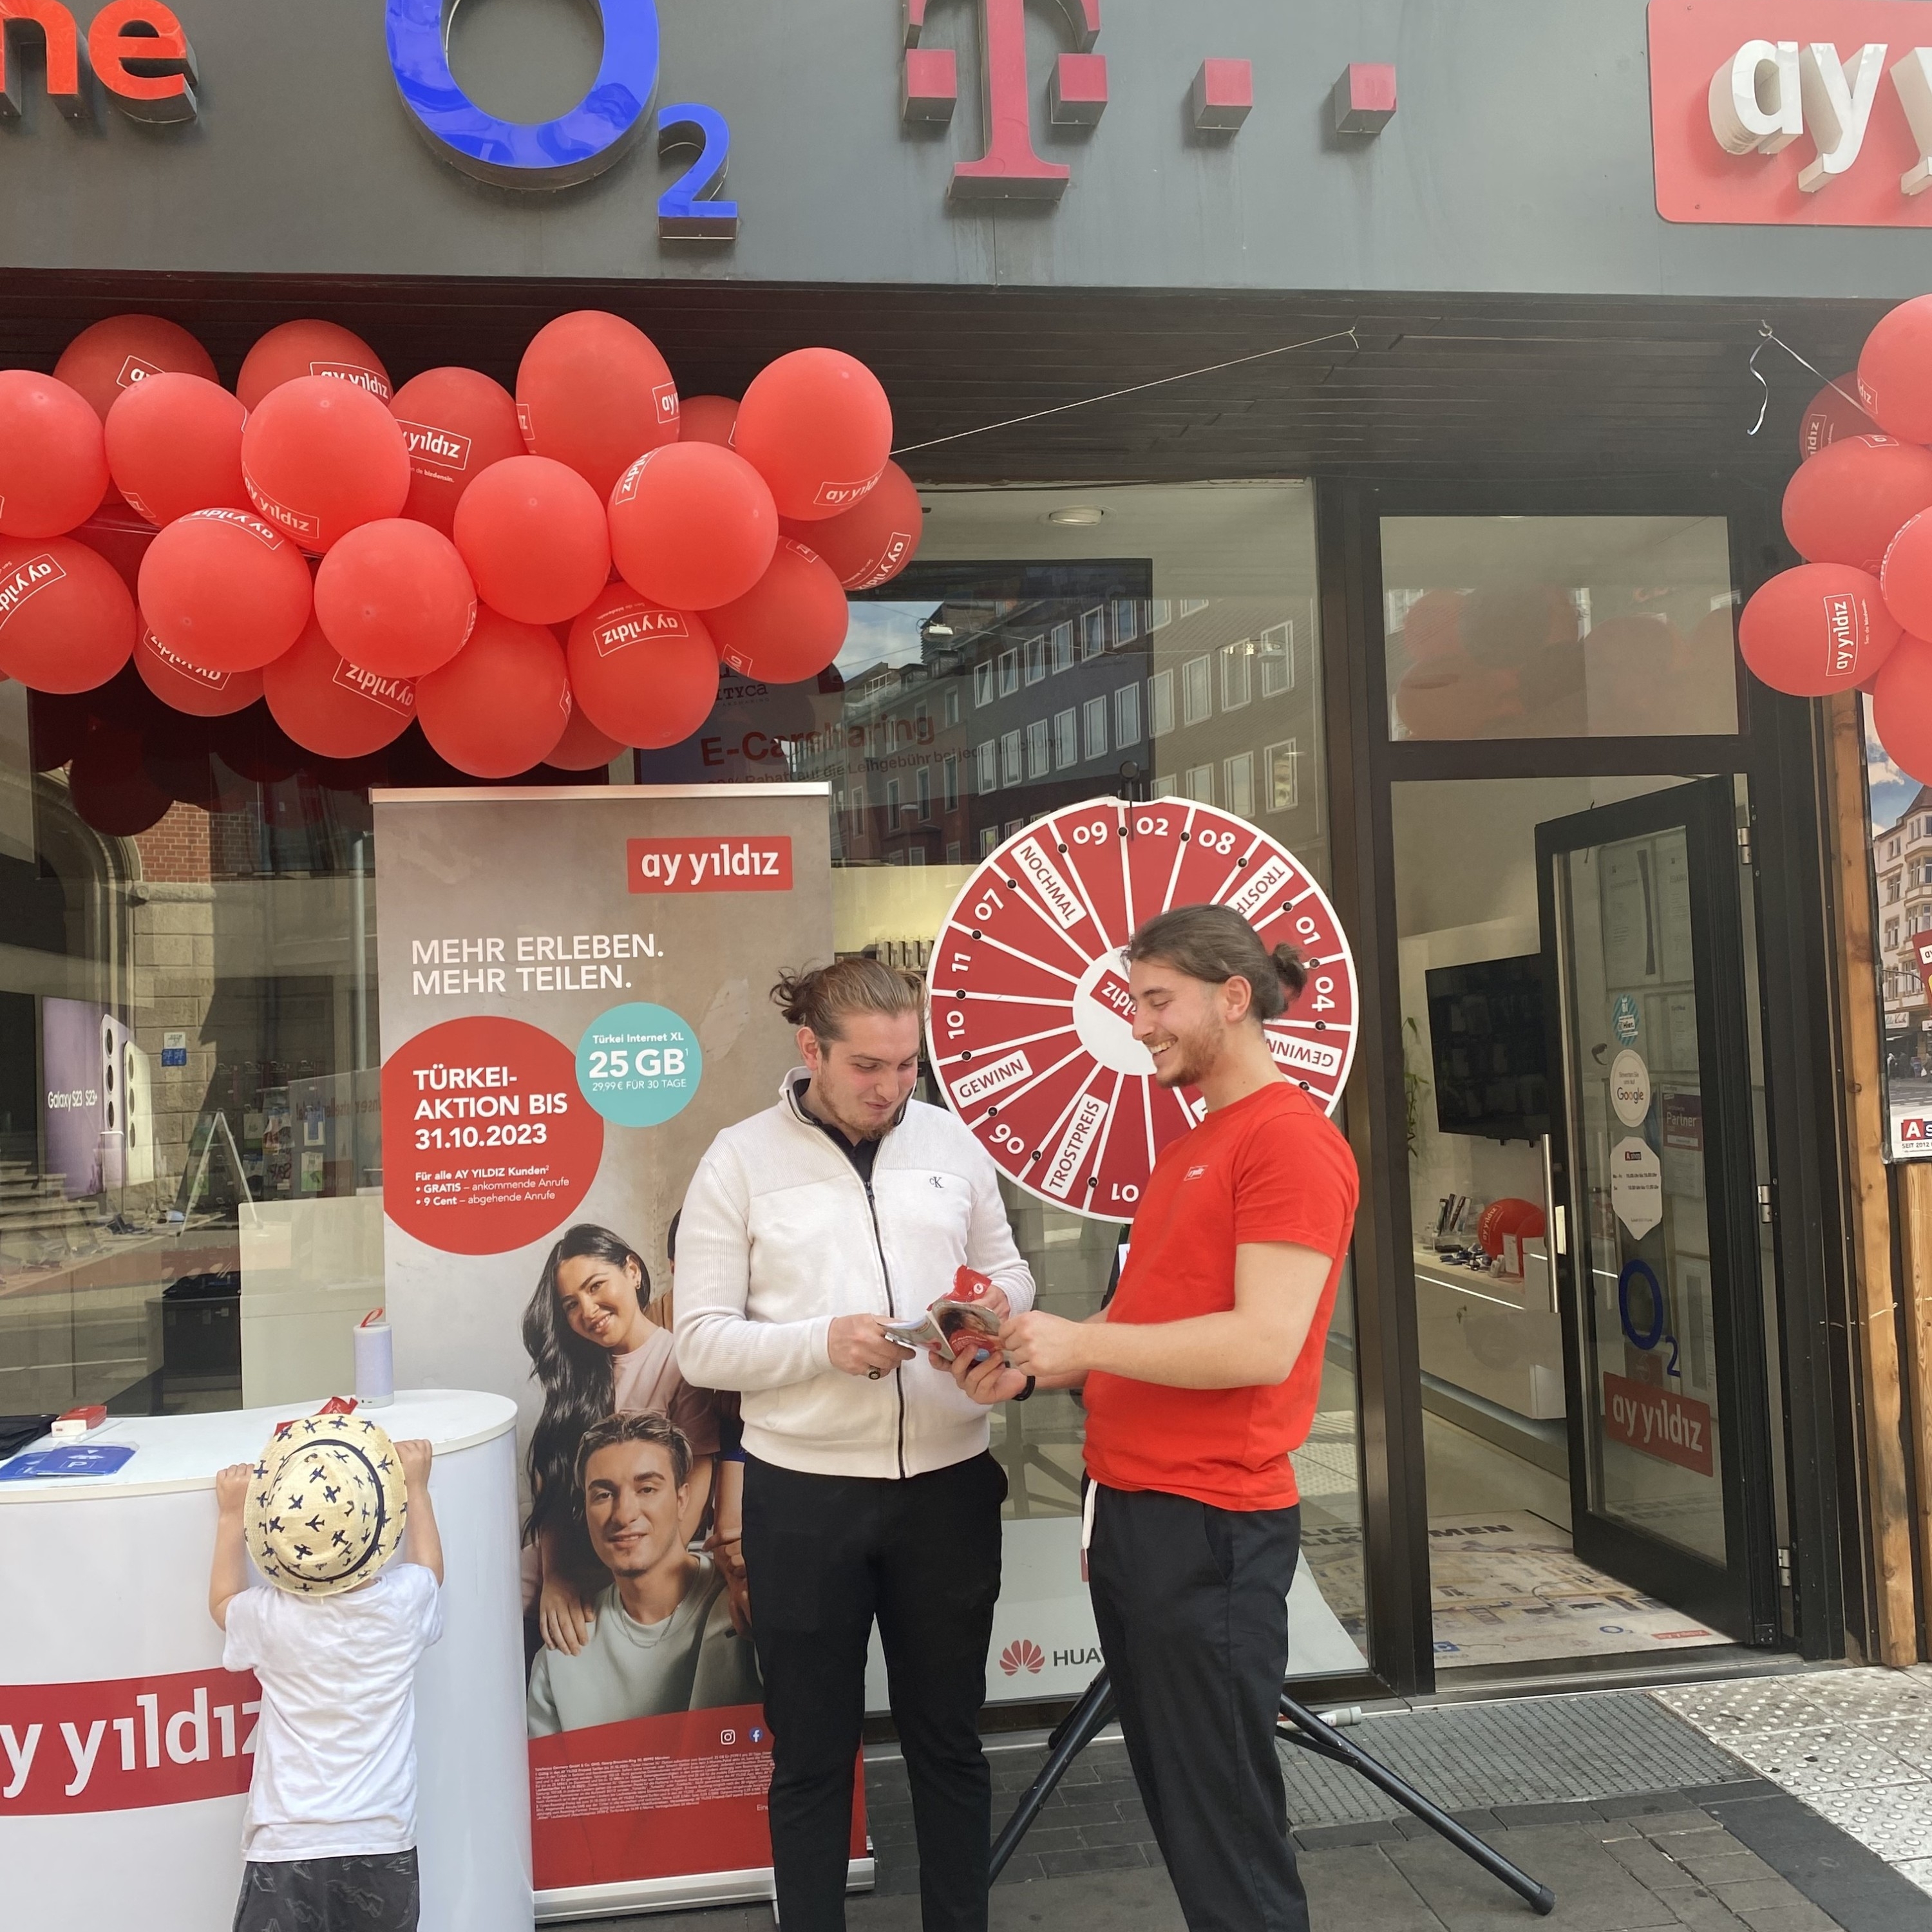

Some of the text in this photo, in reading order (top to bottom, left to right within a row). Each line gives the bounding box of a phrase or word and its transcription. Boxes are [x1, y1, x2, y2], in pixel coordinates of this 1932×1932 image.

[1732, 39, 1888, 174] ay
[701, 714, 934, 766] E-Carsharing
[1072, 821, 1108, 846] 09
[1135, 817, 1170, 837] 02
[1198, 829, 1236, 855] 08
[641, 843, 779, 886] ay yıldız
[1019, 844, 1076, 922] NOCHMAL
[1236, 865, 1286, 916] TROSTP
[974, 887, 1005, 921] 07
[1295, 916, 1321, 945] 01
[411, 933, 665, 965] MEHR ERLEBEN.
[951, 952, 972, 972] 11
[412, 965, 632, 996] MEHR TEILEN.
[1311, 976, 1336, 1012] 04
[592, 1032, 684, 1044] Türkei Internet XL
[946, 1010, 965, 1039] 10
[413, 1063, 518, 1091] TÜRKEI-
[589, 1050, 629, 1079] 25
[959, 1058, 1025, 1099] GEWINN
[626, 1079, 645, 1090] FÜR
[647, 1079, 659, 1090] 30
[661, 1079, 687, 1089] TAGE
[1616, 1086, 1644, 1104] Google
[48, 1090, 71, 1112] Galaxy
[72, 1090, 82, 1107] S23
[414, 1092, 568, 1121] AKTION BIS
[1666, 1112, 1697, 1128] Partner
[415, 1123, 547, 1150] 31.10.2023
[1048, 1101, 1100, 1189] TROSTPREIS
[415, 1171, 433, 1182] Für
[435, 1170, 452, 1180] alle
[455, 1170, 469, 1180] AY
[471, 1168, 506, 1179] YILDIZ
[423, 1177, 570, 1194] GRATIS ankommende Anrufe
[424, 1191, 556, 1206] 9 Cent abgehende Anrufe
[1613, 1394, 1703, 1452] ay yıldız
[1053, 1647, 1102, 1667] HUA
